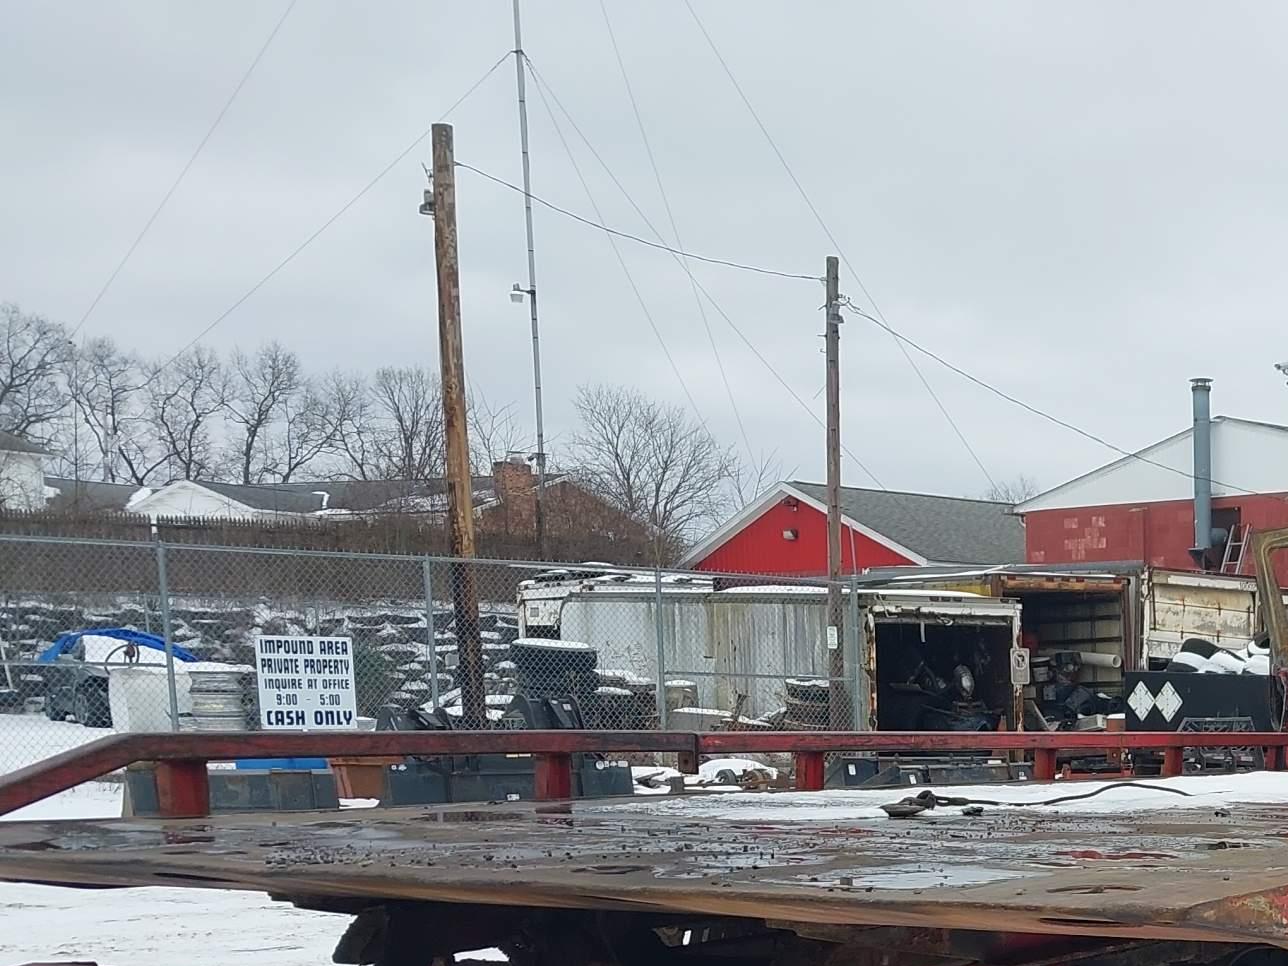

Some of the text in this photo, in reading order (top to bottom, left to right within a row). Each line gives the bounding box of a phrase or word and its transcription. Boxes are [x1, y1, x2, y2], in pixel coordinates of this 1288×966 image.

[260, 639, 348, 655] IMPOUND AREA
[261, 658, 350, 674] PRIVATE PROPERTY
[265, 678, 350, 691] INQUIRE AT OFFICE
[276, 694, 298, 705] 9:00
[320, 694, 341, 705] 5:00
[267, 710, 352, 725] CASH ONLY
